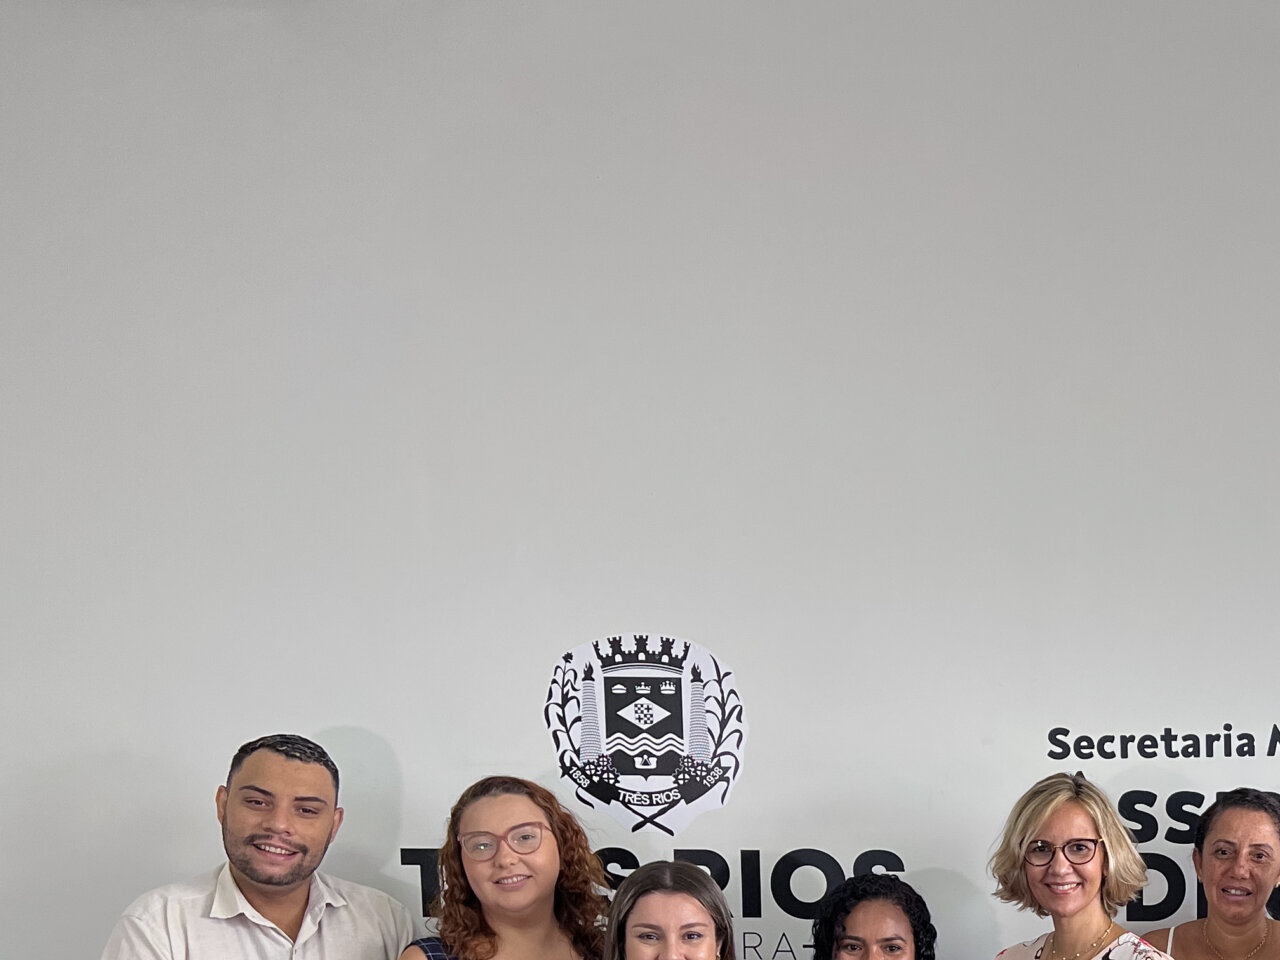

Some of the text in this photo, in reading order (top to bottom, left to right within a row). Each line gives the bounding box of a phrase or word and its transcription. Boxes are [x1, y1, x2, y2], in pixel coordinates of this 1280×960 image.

[1047, 723, 1255, 760] Secretaria
[569, 766, 590, 788] 1858
[702, 766, 724, 788] 1938
[618, 788, 682, 805] TRÊS RIOS
[400, 847, 640, 917] TS
